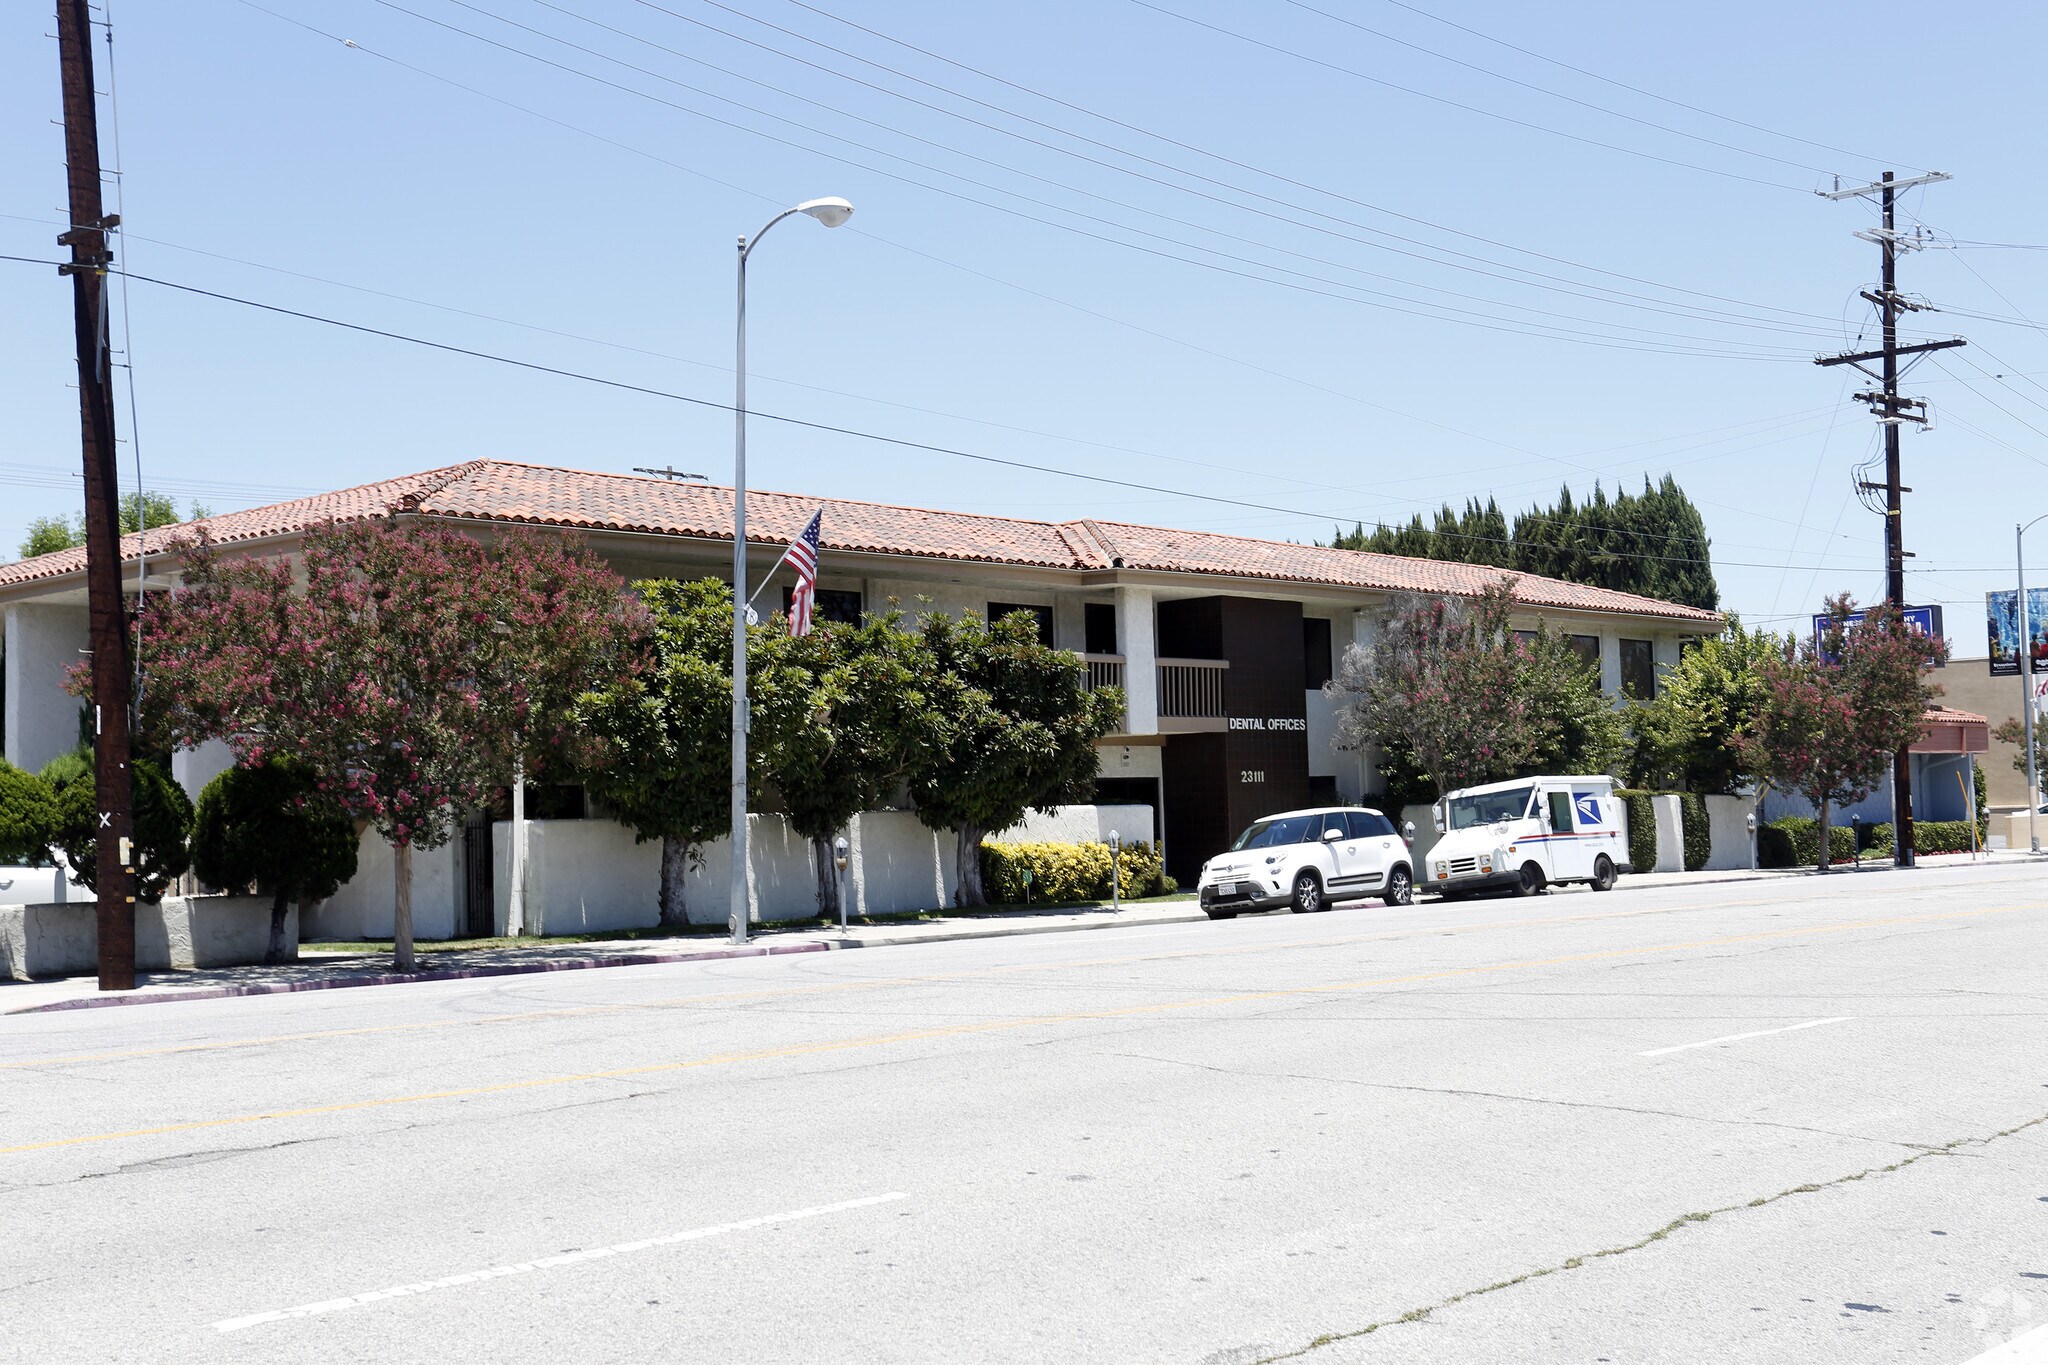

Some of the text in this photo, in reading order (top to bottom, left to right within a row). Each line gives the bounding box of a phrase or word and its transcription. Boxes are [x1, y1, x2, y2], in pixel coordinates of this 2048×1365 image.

[1229, 717, 1306, 731] DENTAL OFFICES
[1241, 770, 1265, 783] 23111
